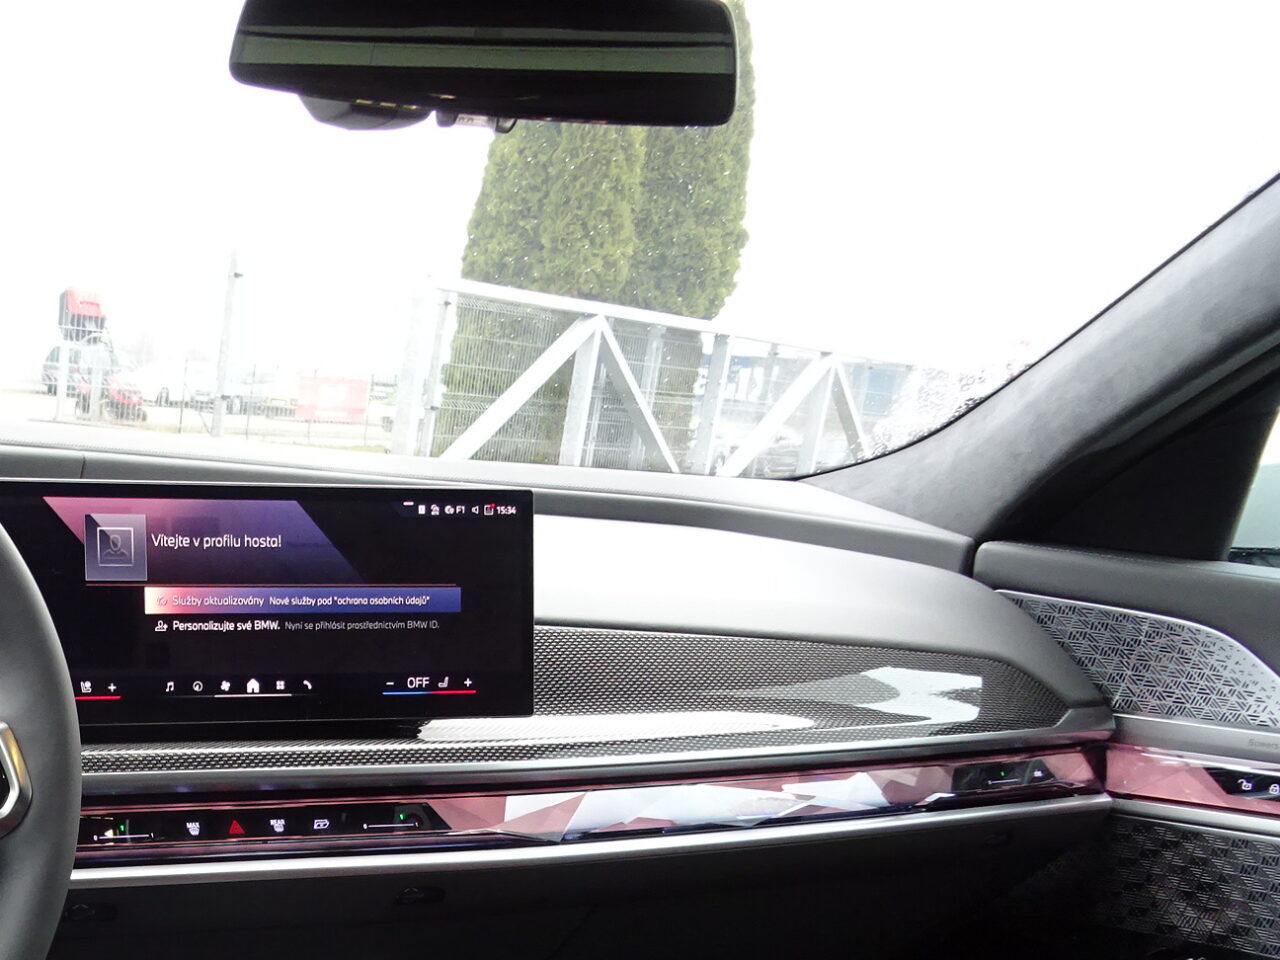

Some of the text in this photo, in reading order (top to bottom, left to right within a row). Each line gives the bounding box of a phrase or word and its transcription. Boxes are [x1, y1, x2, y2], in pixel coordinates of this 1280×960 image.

[496, 505, 517, 515] 15:34
[151, 533, 282, 550] Vítejte v profilu hosta!
[172, 595, 264, 609] Služby aktualizovány
[269, 596, 289, 606] Nové
[291, 595, 315, 608] služby
[317, 596, 332, 608] pod
[370, 595, 404, 606] osobních
[172, 620, 280, 632] Personalizujte své BMW.
[407, 620, 428, 629] BMW
[407, 677, 430, 688] OFF
